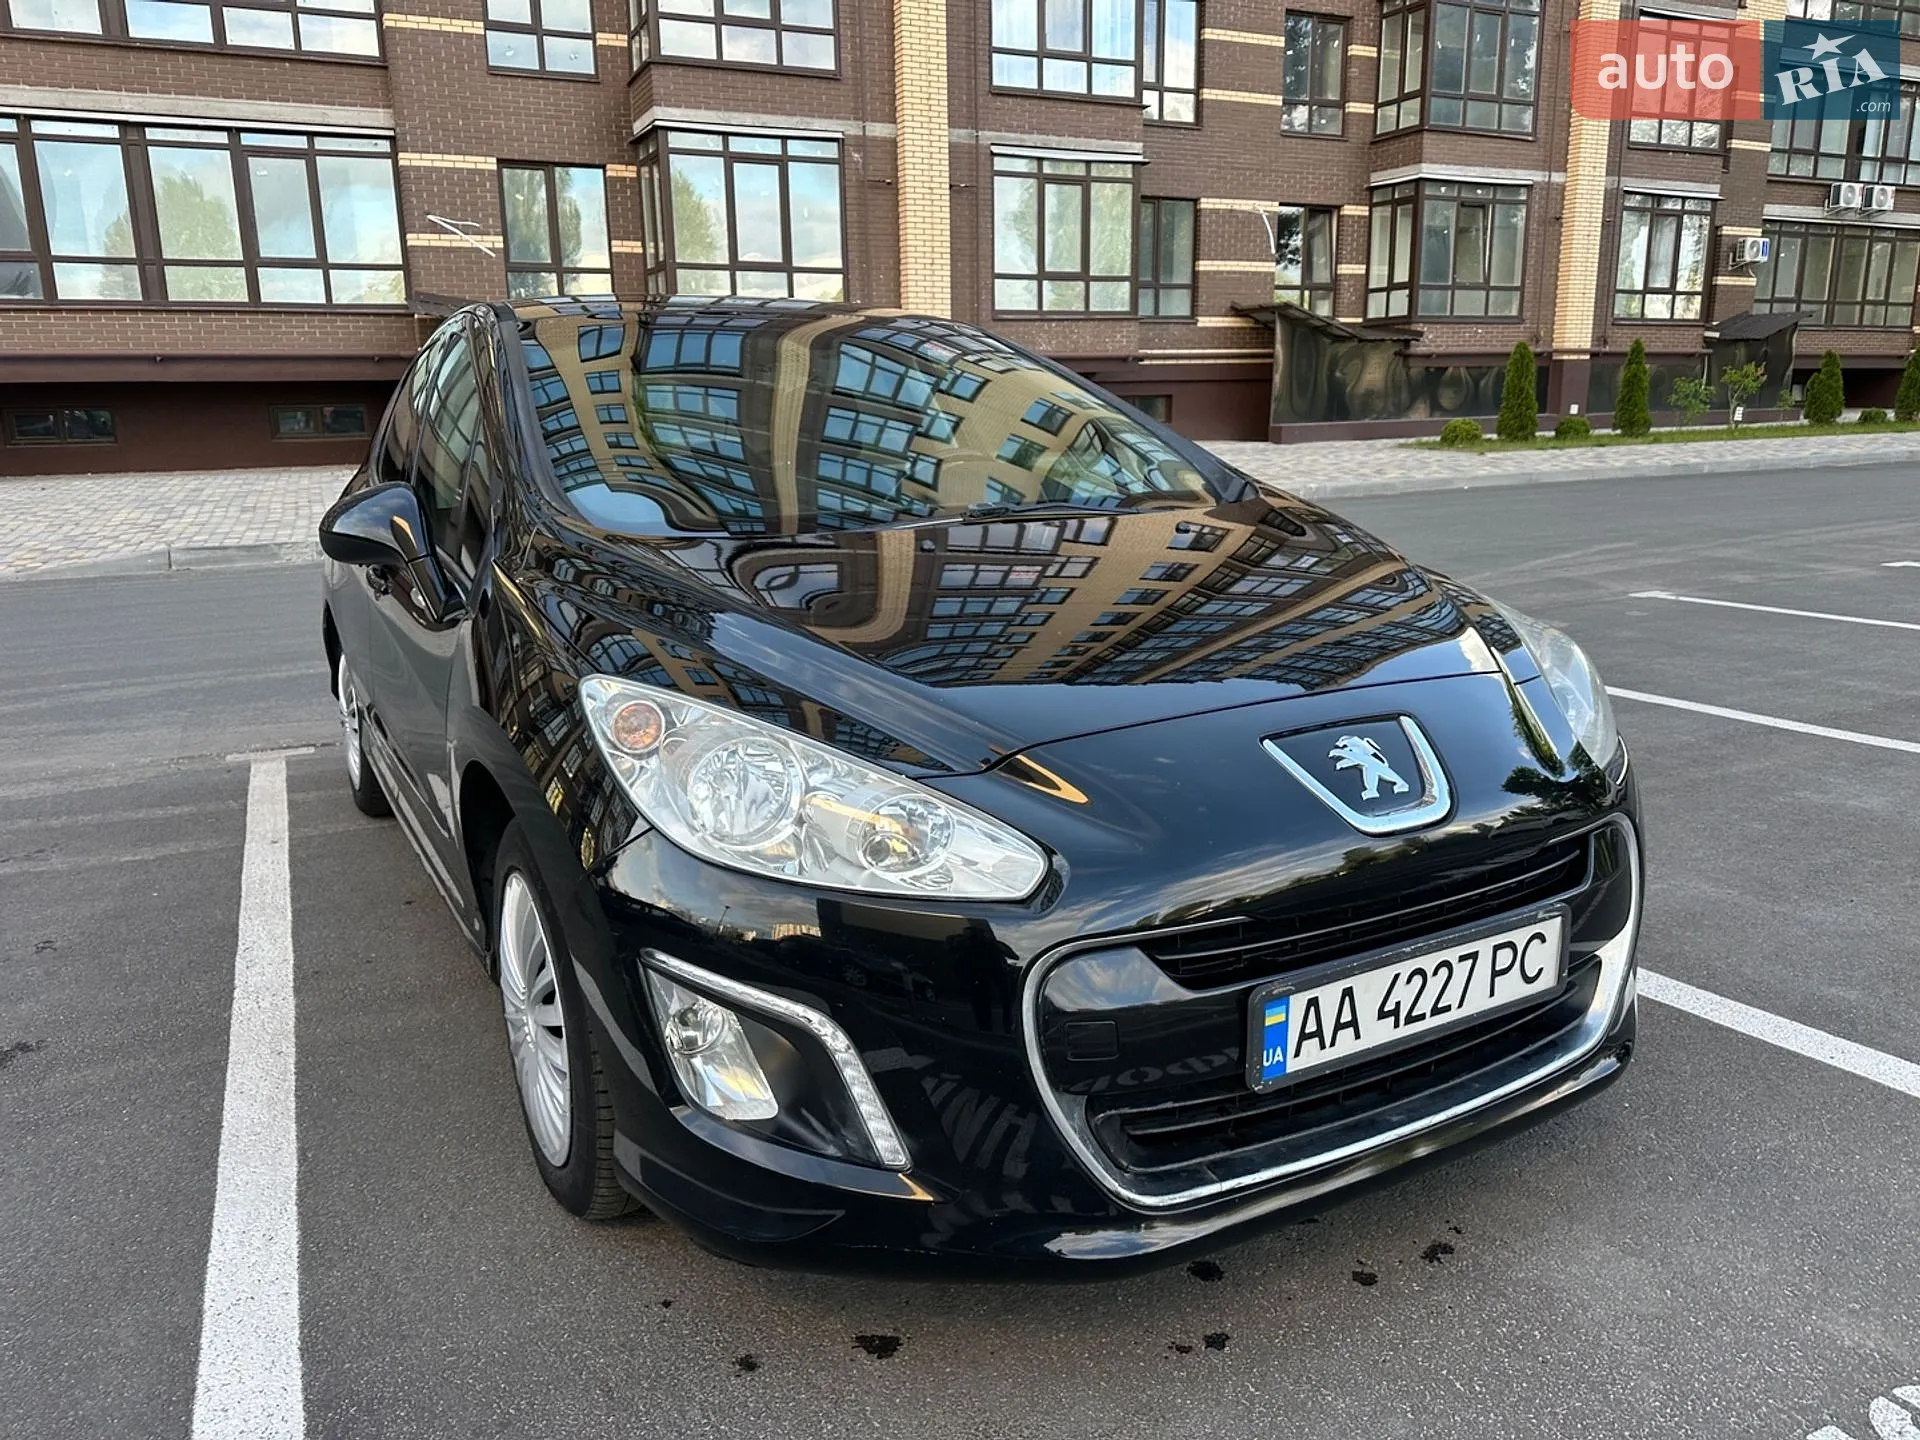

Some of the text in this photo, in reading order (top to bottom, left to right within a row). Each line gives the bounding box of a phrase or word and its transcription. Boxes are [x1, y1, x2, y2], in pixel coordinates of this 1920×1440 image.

[1293, 931, 1547, 1059] AA 4227 PC
[1262, 1045, 1285, 1067] UA
